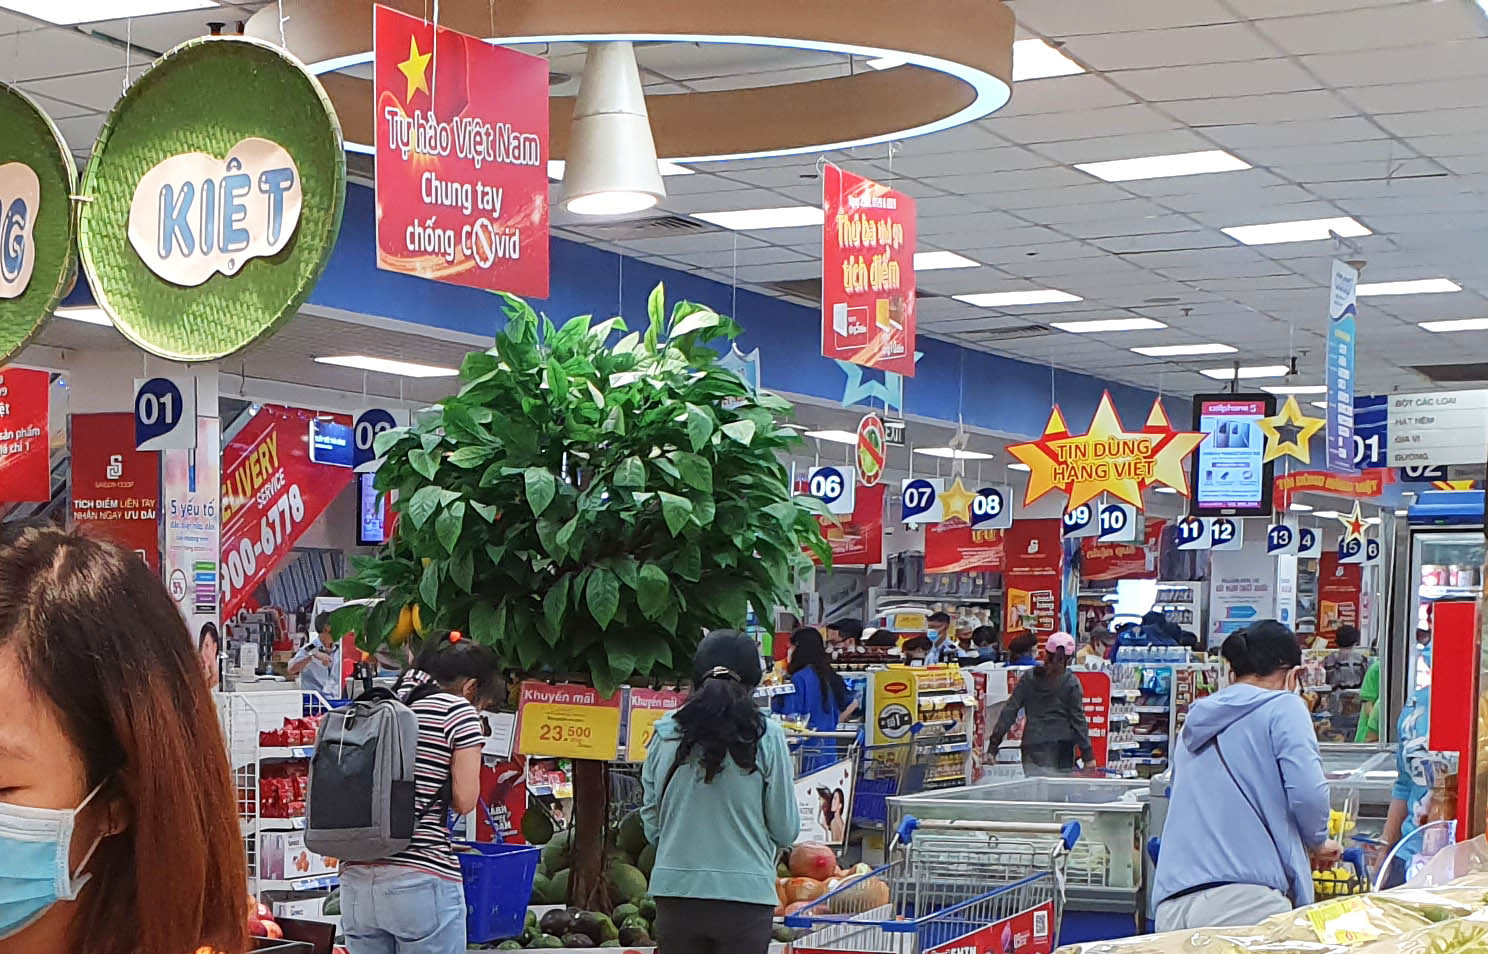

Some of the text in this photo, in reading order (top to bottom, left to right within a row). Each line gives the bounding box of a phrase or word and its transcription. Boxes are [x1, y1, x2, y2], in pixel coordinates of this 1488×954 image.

[384, 106, 540, 168] Tự hào Việt Nam
[421, 171, 503, 218] Chung tay
[157, 156, 295, 272] KIỆT
[406, 216, 455, 262] chống
[138, 391, 174, 425] 01
[1057, 437, 1152, 460] TIN DÙNG
[222, 430, 279, 522] ELIVERY
[1053, 457, 1155, 481] HÀNG VIỆT
[256, 467, 285, 510] SERVICE
[811, 475, 841, 497] 06
[170, 499, 177, 515] 5
[904, 488, 932, 508] 07
[973, 494, 1000, 515] 08
[1100, 512, 1119, 529] 10
[1179, 521, 1199, 538] 11
[1212, 523, 1232, 539] 12
[222, 483, 305, 603] 900-6778
[1270, 531, 1289, 545] 13
[523, 689, 595, 704] Khuyến mãi
[631, 695, 662, 709] Khuyến
